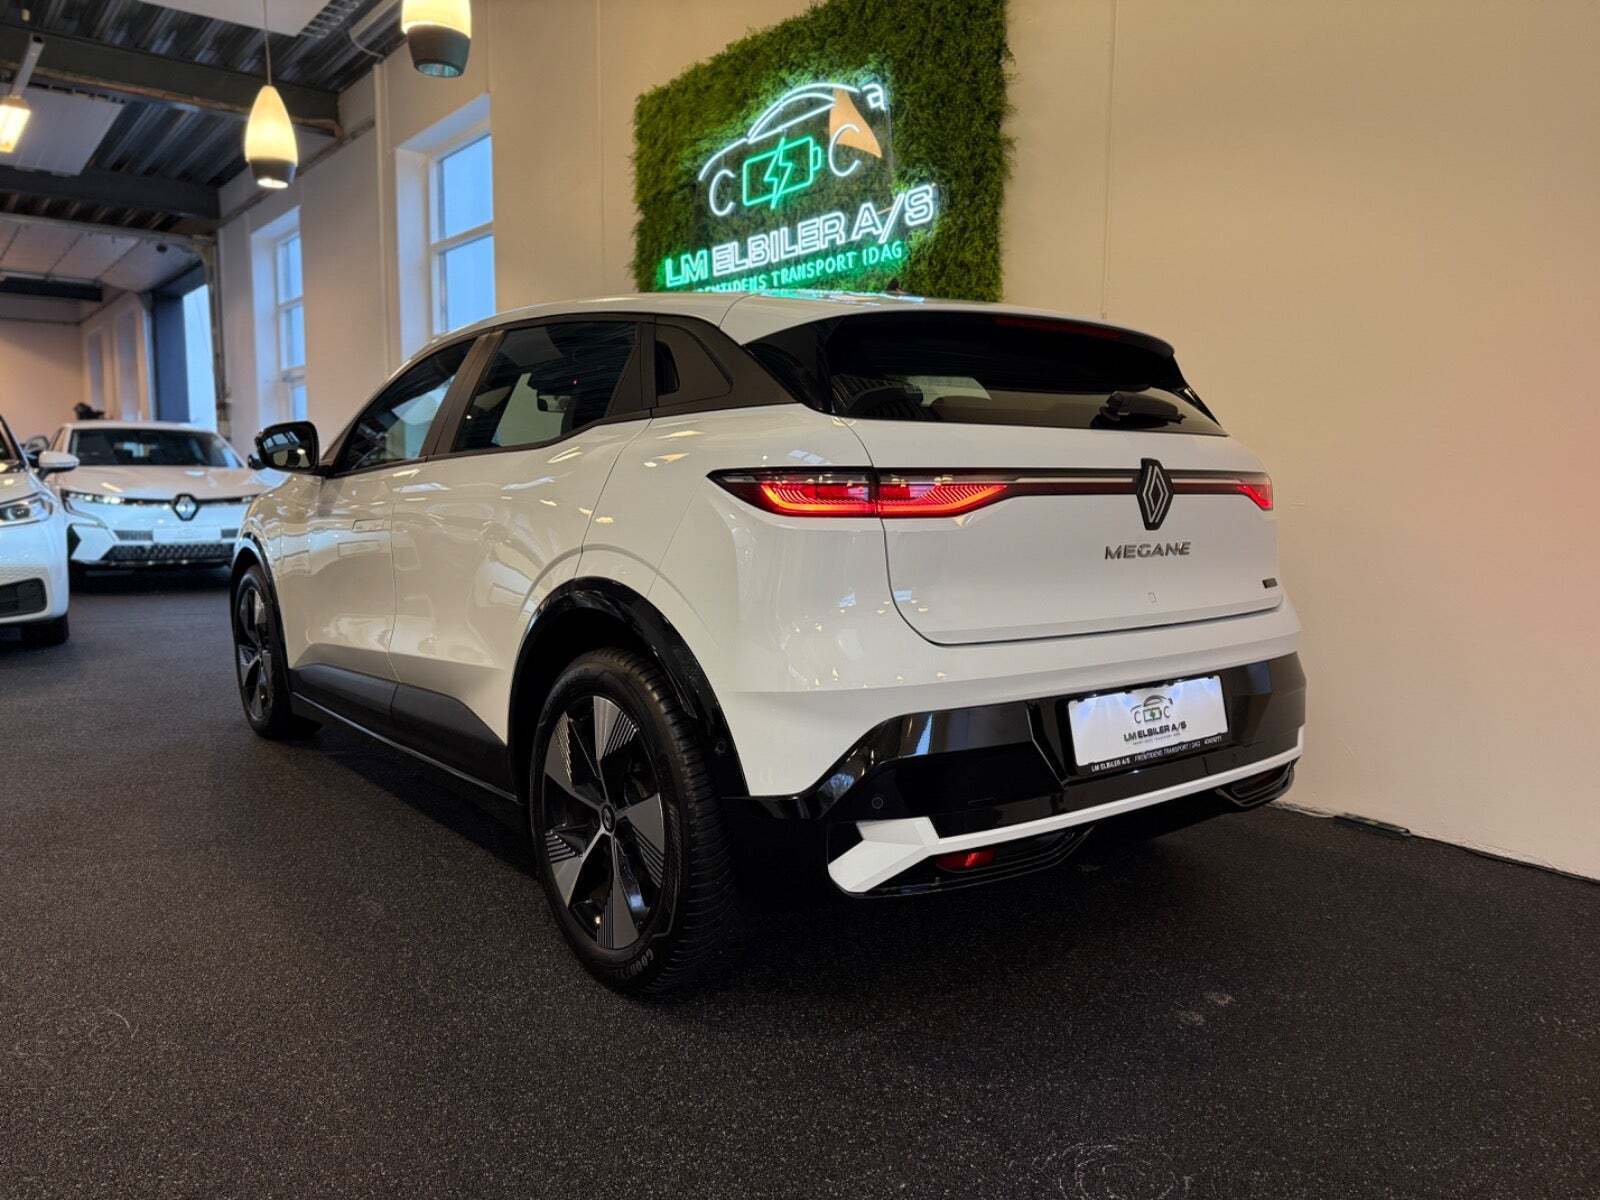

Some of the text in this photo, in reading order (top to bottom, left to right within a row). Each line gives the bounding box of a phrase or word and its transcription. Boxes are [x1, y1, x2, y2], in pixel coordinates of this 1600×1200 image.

[664, 183, 935, 288] LM ELBILER A/S
[771, 250, 858, 291] TRANSPORT
[1104, 541, 1191, 560] MEGANE
[1123, 731, 1137, 742] LM
[1137, 724, 1170, 739] ELBILER
